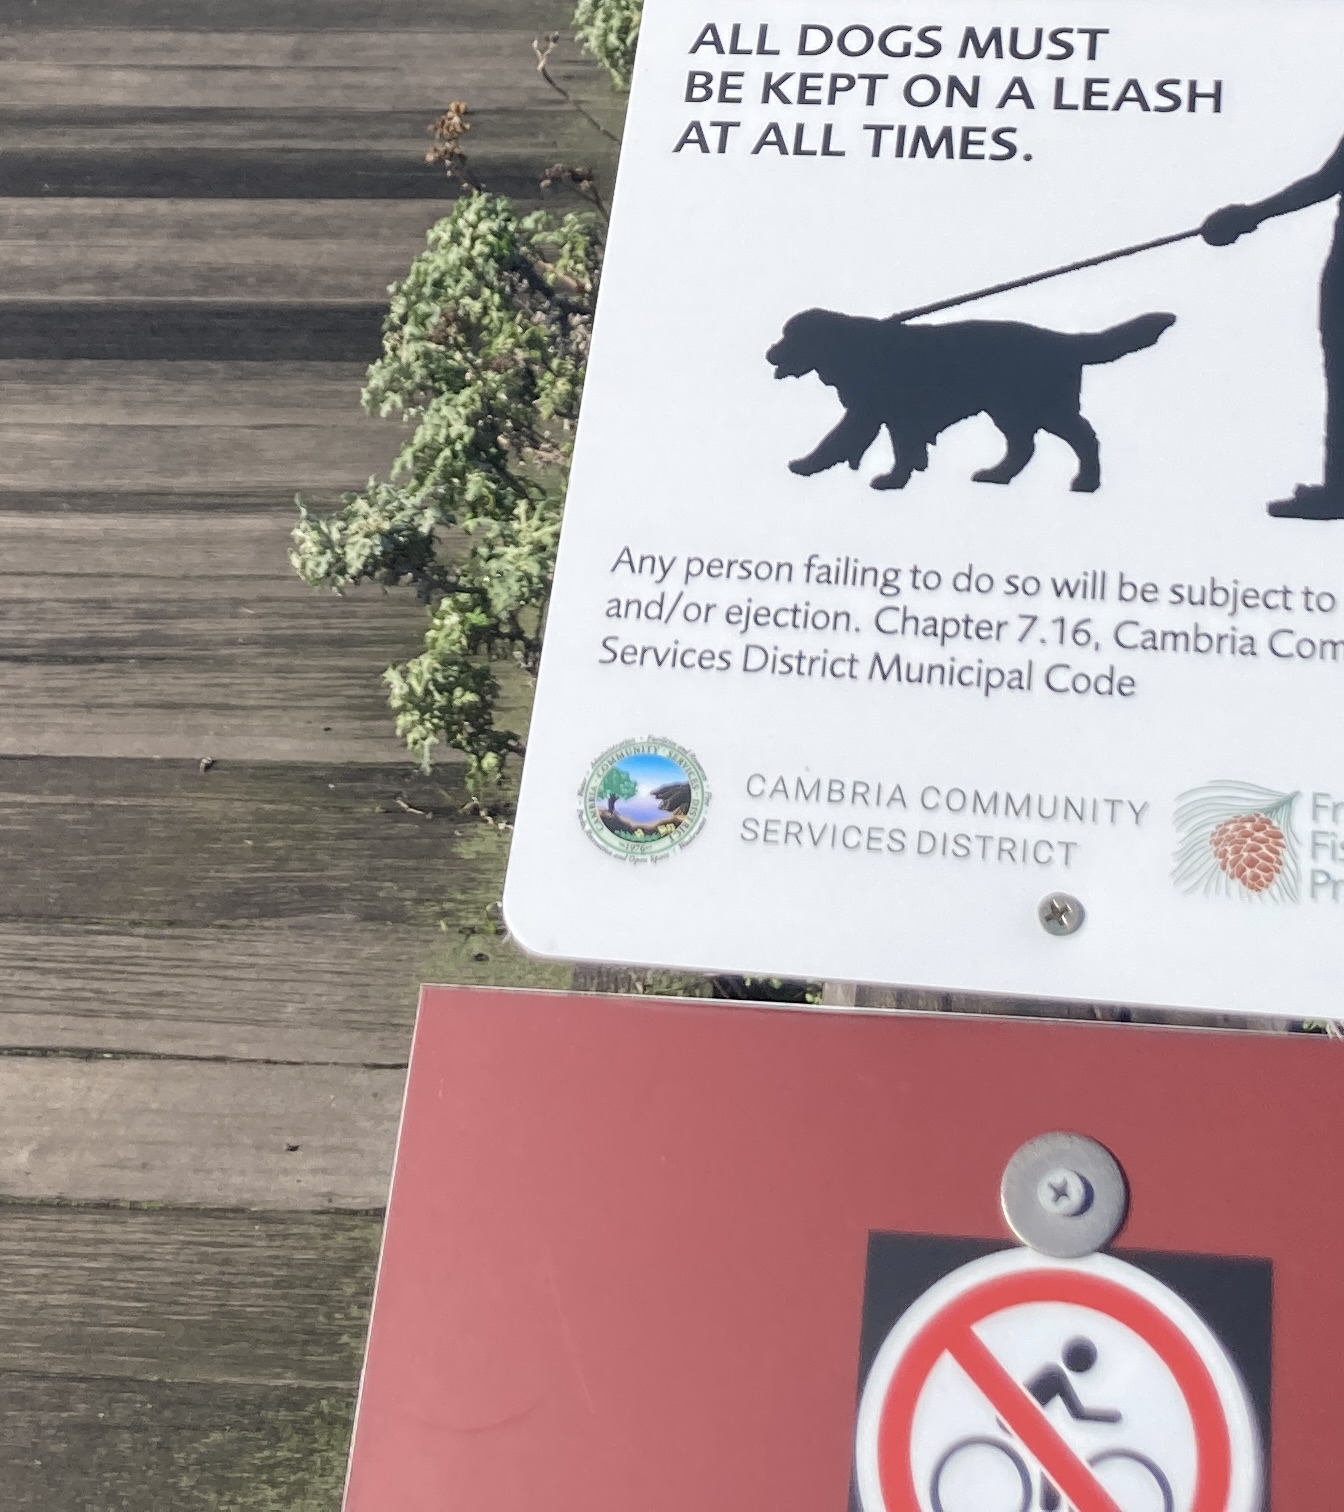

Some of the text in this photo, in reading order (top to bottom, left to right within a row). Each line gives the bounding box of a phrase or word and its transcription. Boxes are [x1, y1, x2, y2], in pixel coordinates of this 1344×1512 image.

[688, 23, 1109, 60] ALL DOGS MUST
[685, 71, 1222, 113] BE KEPT ON A LEASH
[672, 121, 1032, 161] AT ALL TIMES.
[611, 546, 676, 584] Any
[684, 557, 793, 585] person
[804, 554, 901, 597] failing
[910, 565, 941, 591] to
[952, 564, 994, 594] do
[1004, 575, 1041, 596] so
[1051, 570, 1106, 600] will
[1118, 572, 1159, 604] be
[1169, 577, 1293, 617] subject
[1301, 586, 1336, 613] to
[606, 591, 716, 624] and/or
[725, 598, 859, 634] ejection.
[875, 605, 1008, 647] Chapter
[1018, 614, 1099, 651] 7.16,
[1114, 620, 1257, 657] Cambria
[599, 636, 1136, 697] Services District Municipal Code
[747, 773, 907, 809] CAMBRIA
[921, 786, 1148, 826] COMMUNITY
[741, 818, 906, 854] SERVICES
[917, 830, 1078, 867] DISTRICT
